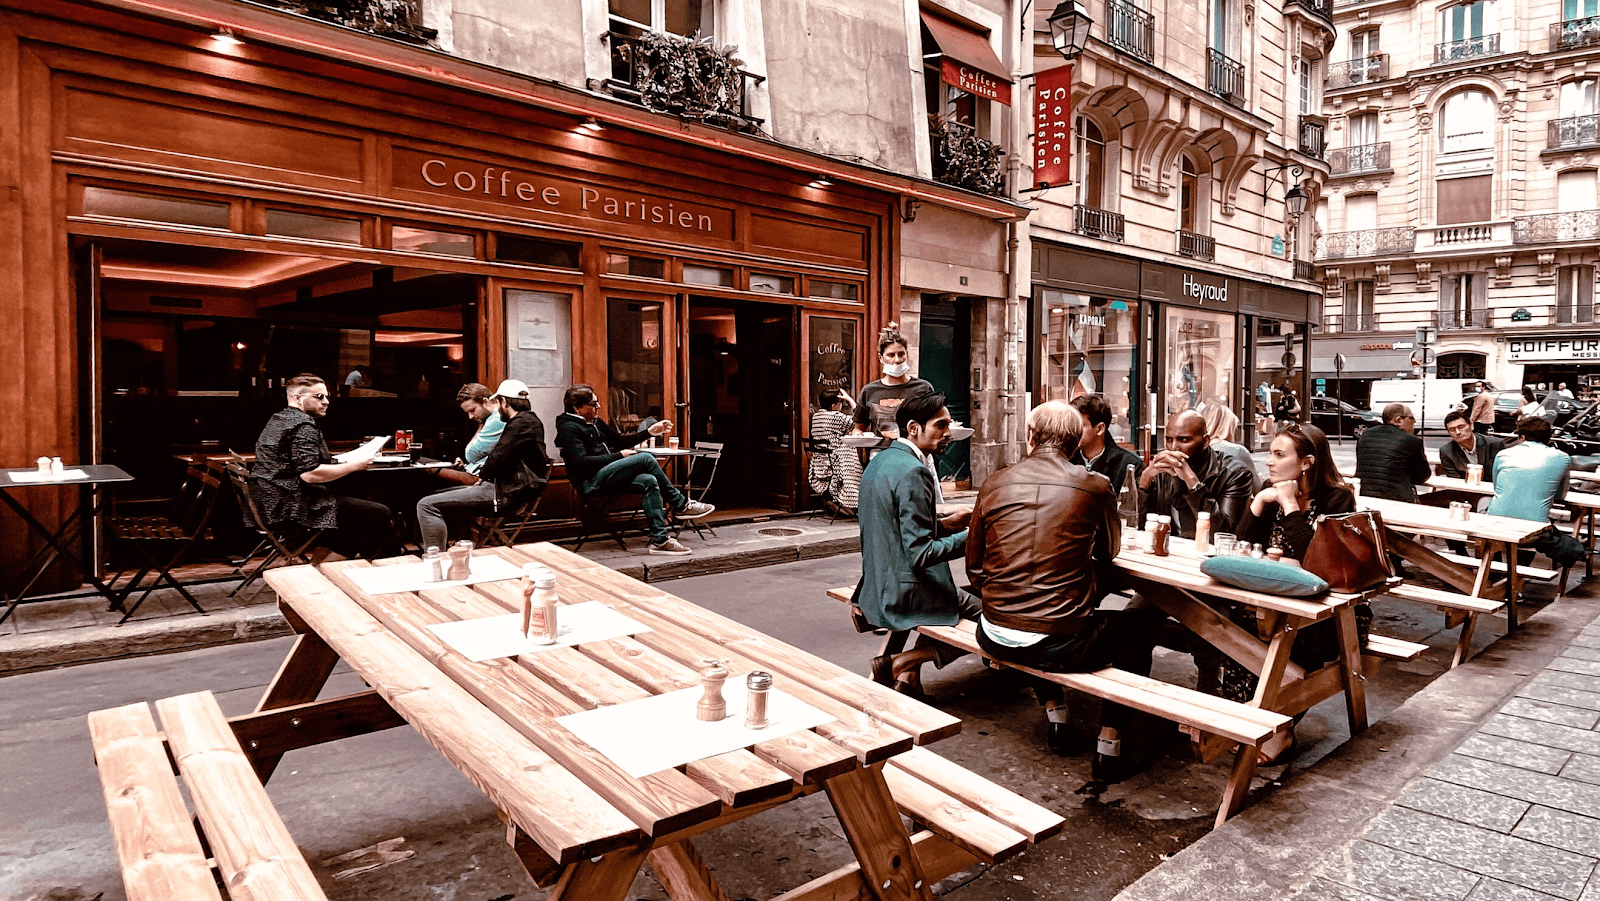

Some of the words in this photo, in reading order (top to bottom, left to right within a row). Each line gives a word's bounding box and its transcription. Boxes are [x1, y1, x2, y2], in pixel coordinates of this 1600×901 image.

[959, 76, 998, 98] Parisien
[960, 67, 997, 88] Coffee
[1038, 89, 1050, 169] Parisien
[1053, 87, 1066, 165] Coffee
[421, 159, 561, 206] Coffee
[580, 187, 713, 232] Parisien
[1183, 273, 1228, 305] Heyraud
[1079, 313, 1106, 327] KAPORAL
[817, 342, 846, 355] Coffee
[817, 372, 848, 386] Parisien
